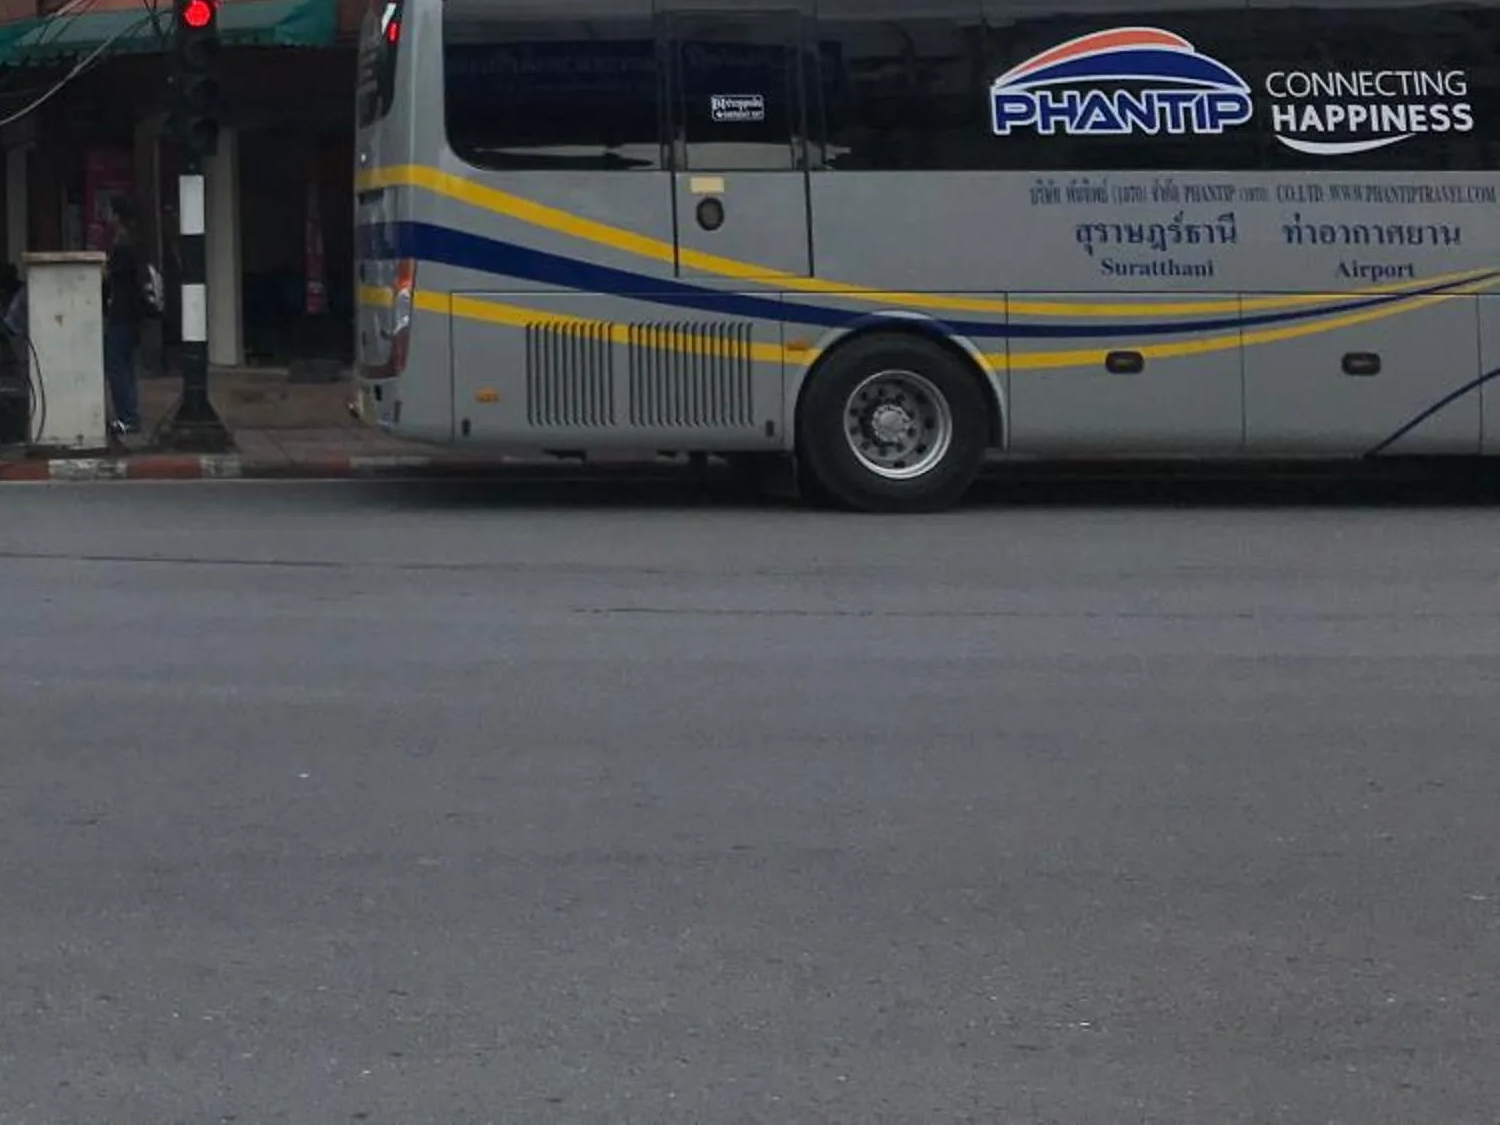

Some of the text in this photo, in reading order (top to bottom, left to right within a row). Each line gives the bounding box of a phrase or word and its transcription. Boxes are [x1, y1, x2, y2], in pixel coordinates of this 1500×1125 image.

[1265, 69, 1467, 100] CONNECTING
[992, 88, 1253, 135] PHANTIP
[1272, 103, 1475, 133] HAPPINESS
[1075, 210, 1462, 256] สุราษฎร์ธานี ท่าอากาศยาน
[1100, 258, 1415, 282] Suratthani Airport
